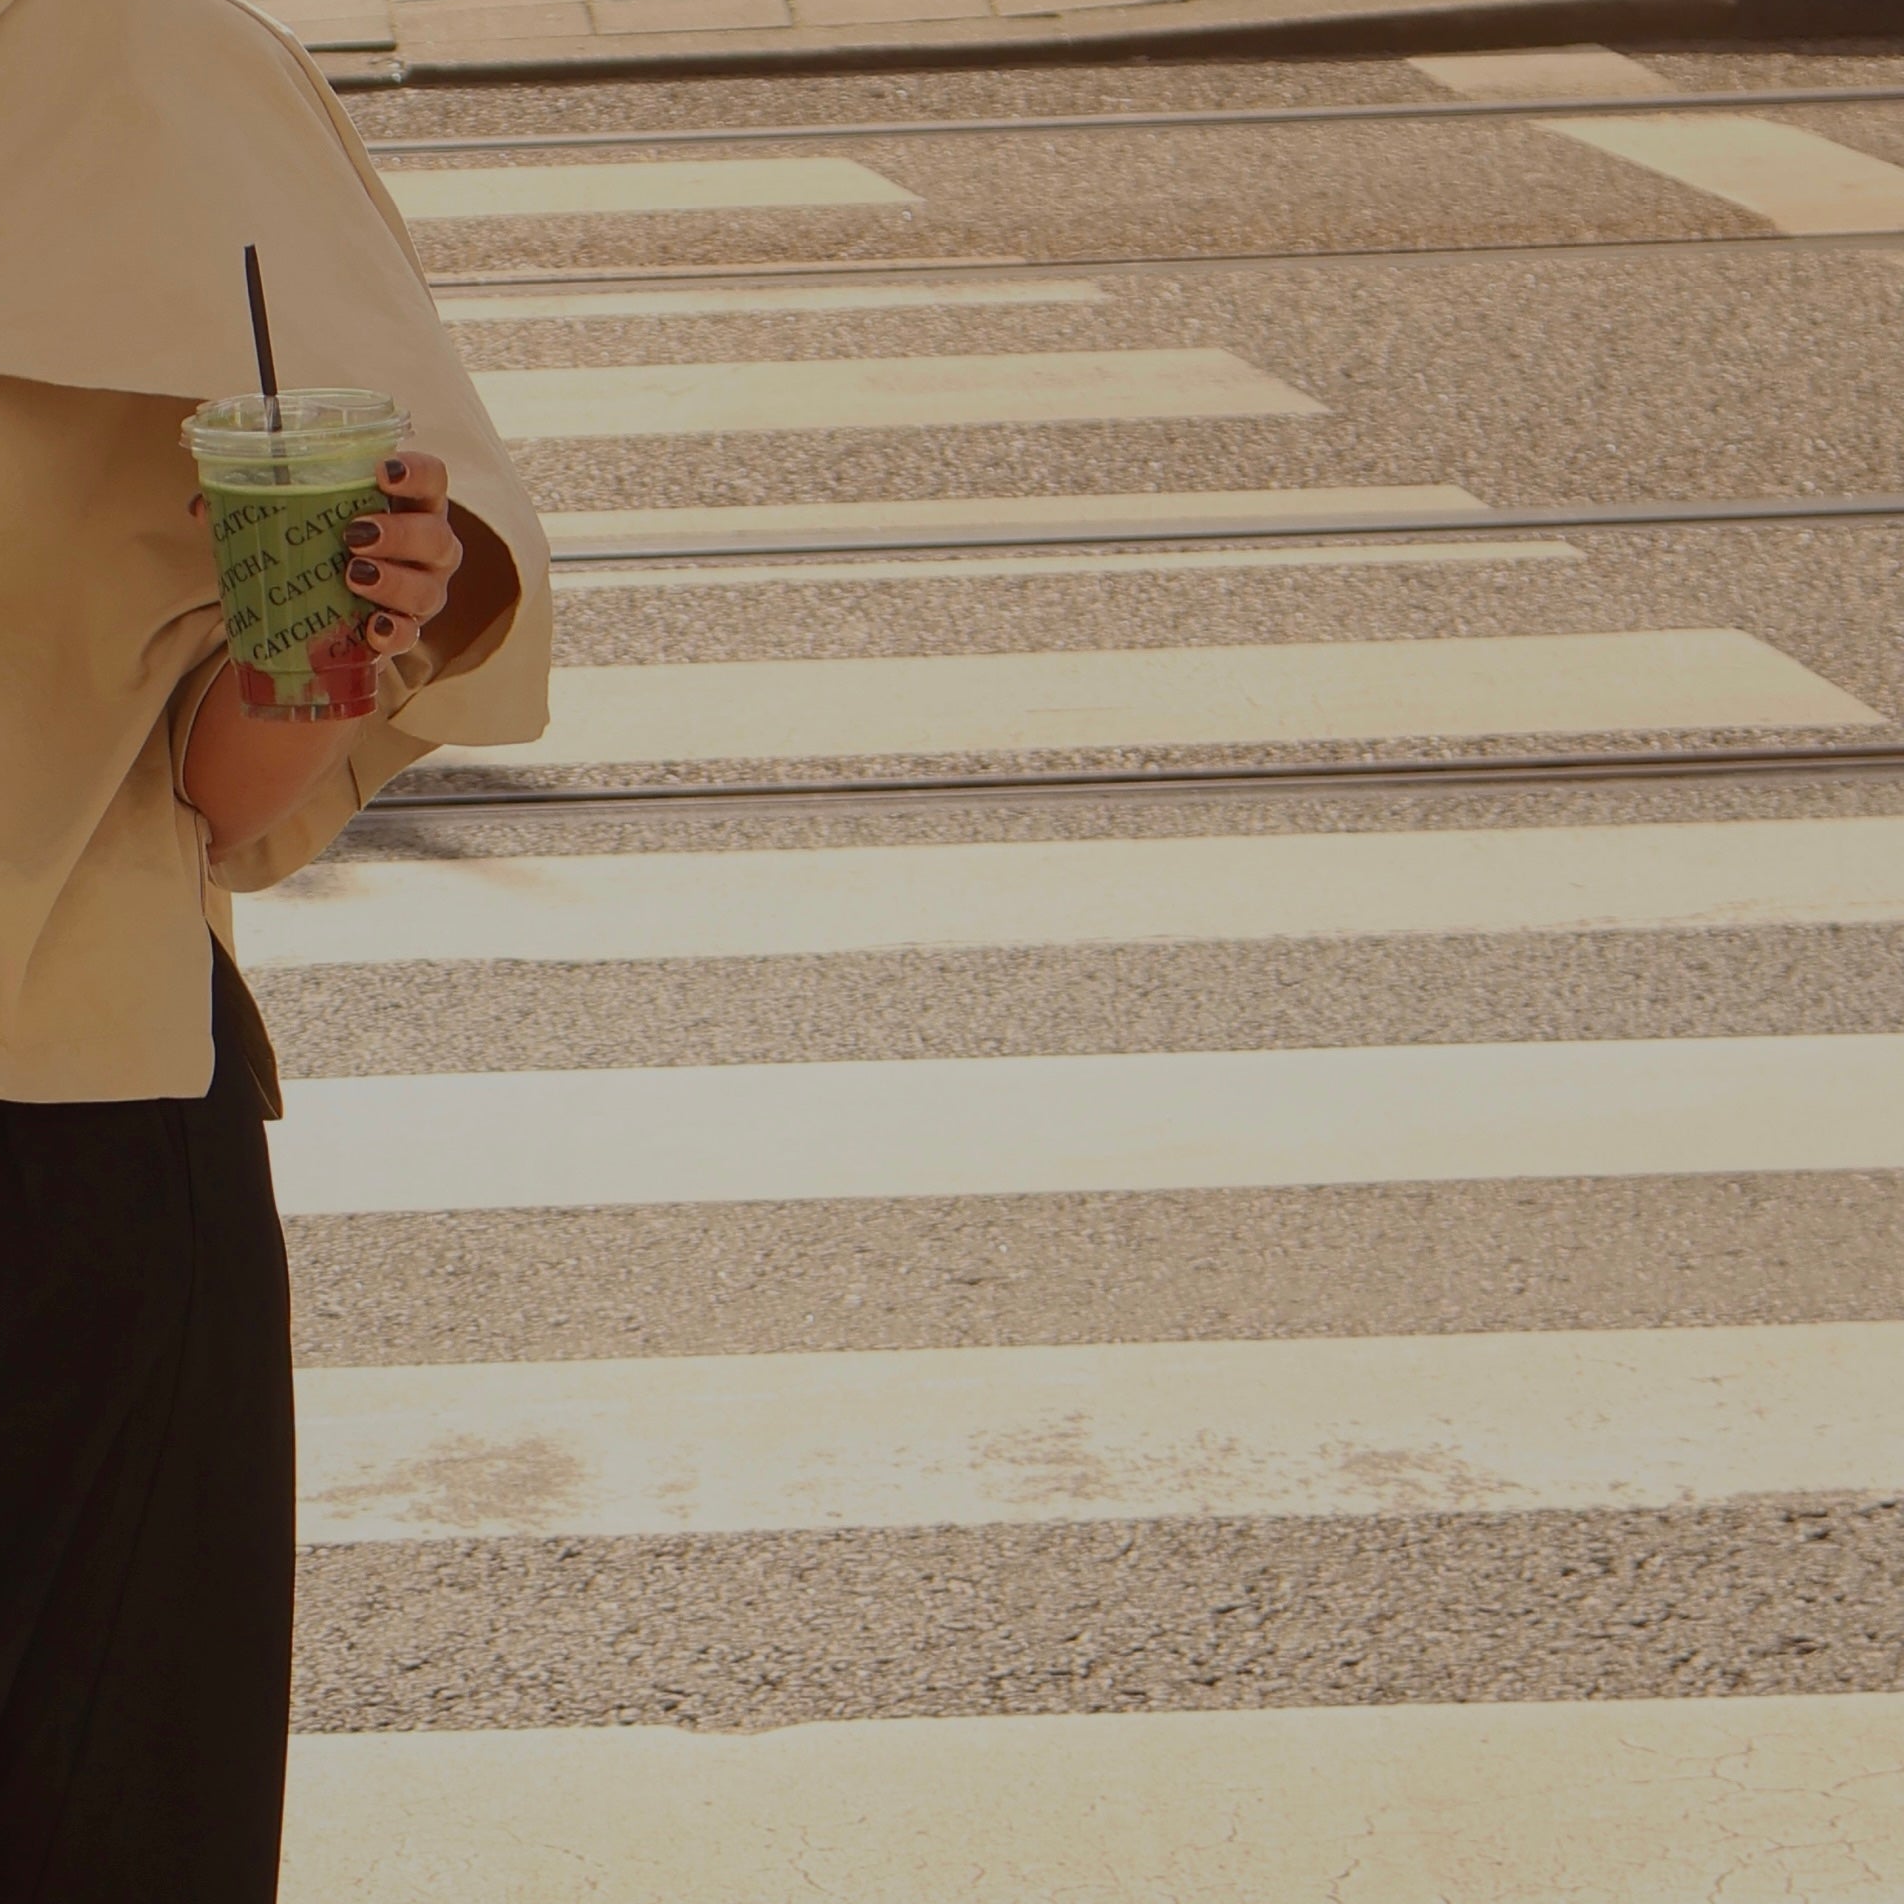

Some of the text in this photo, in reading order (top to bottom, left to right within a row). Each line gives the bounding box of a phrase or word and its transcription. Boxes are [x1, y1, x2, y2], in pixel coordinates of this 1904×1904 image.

[218, 549, 280, 599] ATCHA
[269, 551, 348, 607] CATCH
[253, 606, 342, 662] CATCHA
